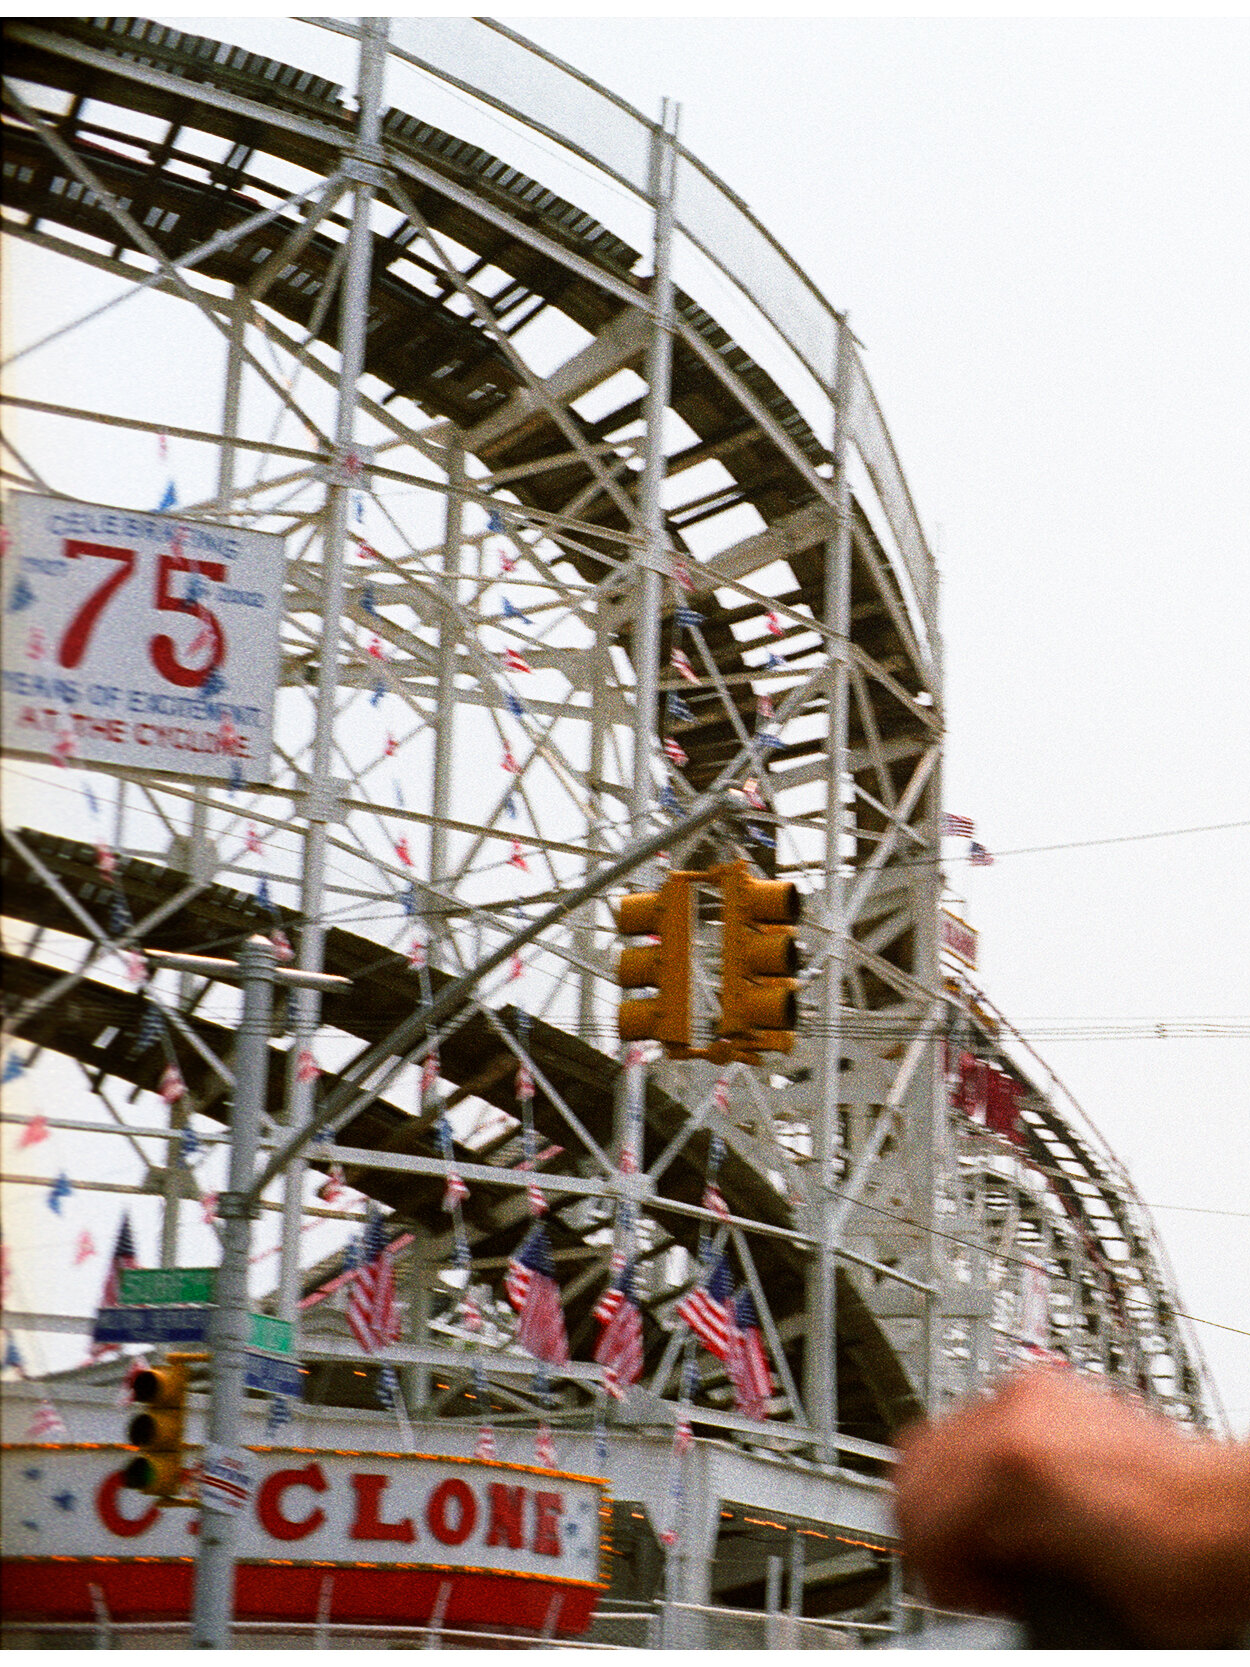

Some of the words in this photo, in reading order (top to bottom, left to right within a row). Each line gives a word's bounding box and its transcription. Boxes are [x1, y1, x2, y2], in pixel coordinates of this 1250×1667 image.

[57, 538, 228, 688] 75
[16, 706, 59, 731] AT
[69, 712, 127, 744] THE
[87, 683, 121, 708] OF
[94, 1461, 566, 1557] CCLONE
